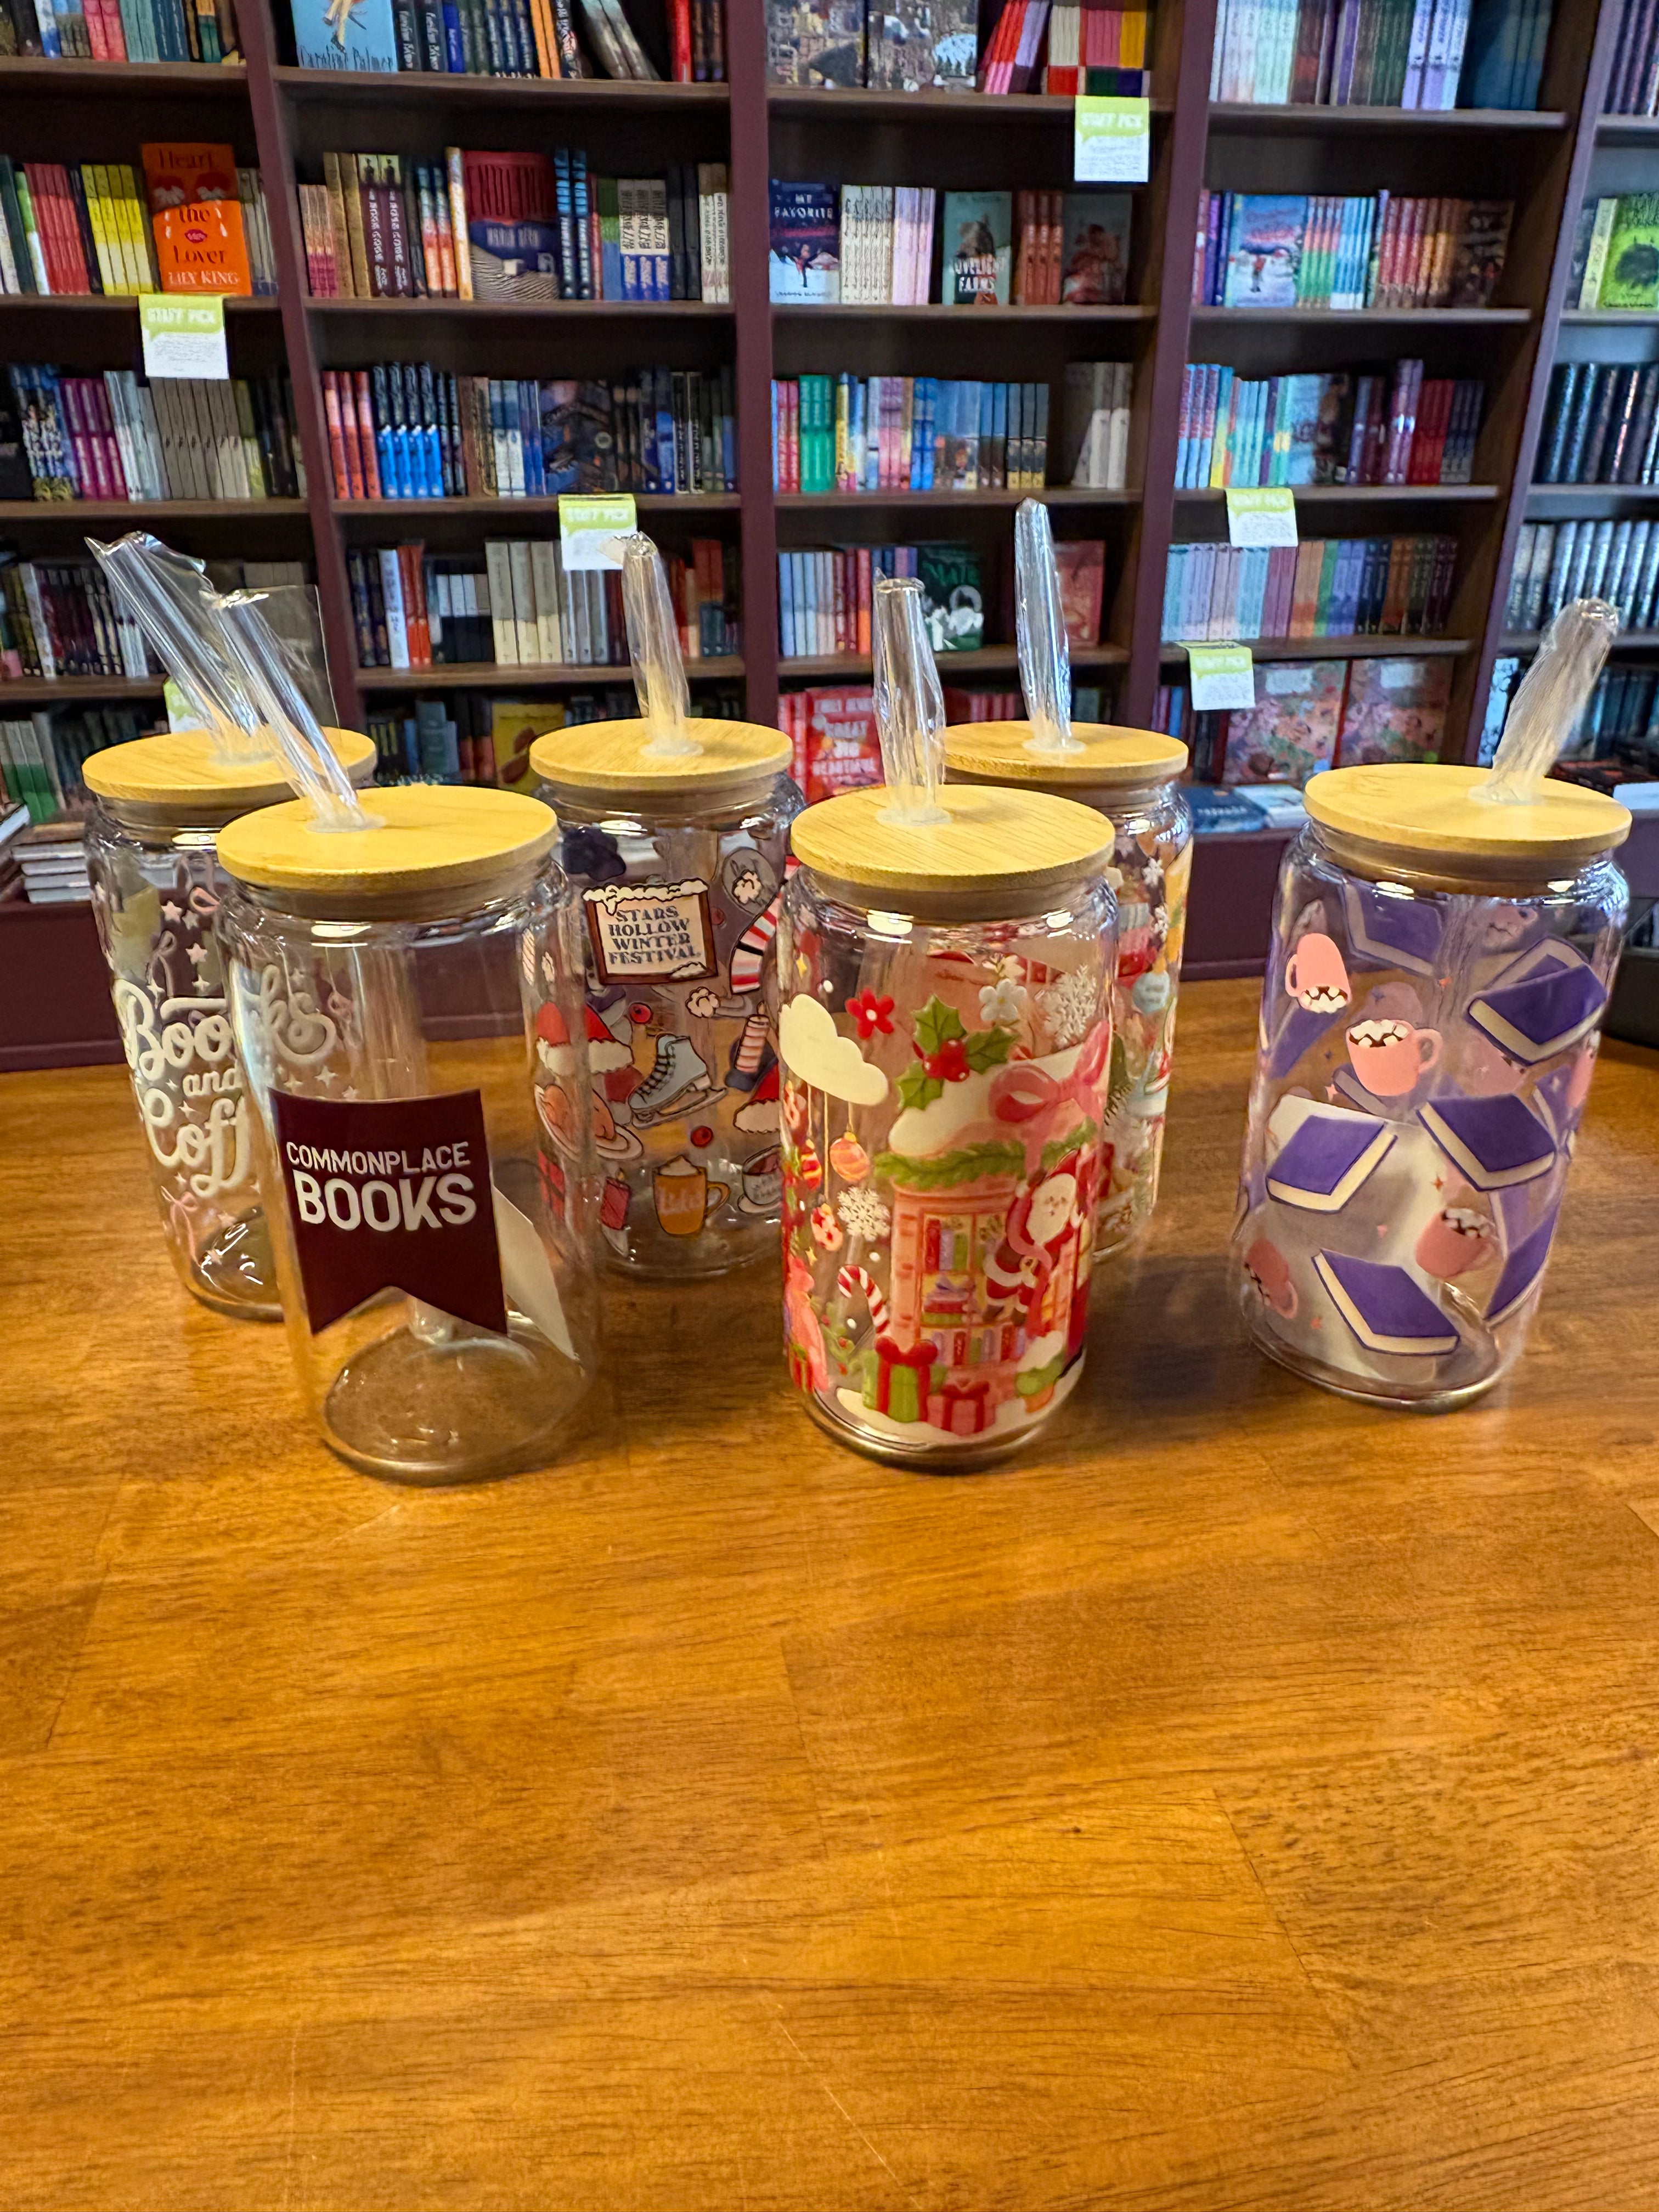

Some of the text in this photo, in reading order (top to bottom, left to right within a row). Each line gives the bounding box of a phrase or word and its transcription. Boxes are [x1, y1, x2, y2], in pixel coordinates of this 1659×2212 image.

[159, 148, 212, 169] Heart
[173, 245, 229, 265] Lover
[168, 270, 240, 286] LILY KING
[616, 905, 679, 923] STARS
[607, 917, 690, 936] HOLLOW
[611, 932, 691, 951] WINTER
[607, 945, 701, 964] FESTIVAL
[136, 1088, 250, 1198] Coff
[286, 1141, 471, 1176] COMMONPLACE
[292, 1169, 477, 1233] BOOKS
